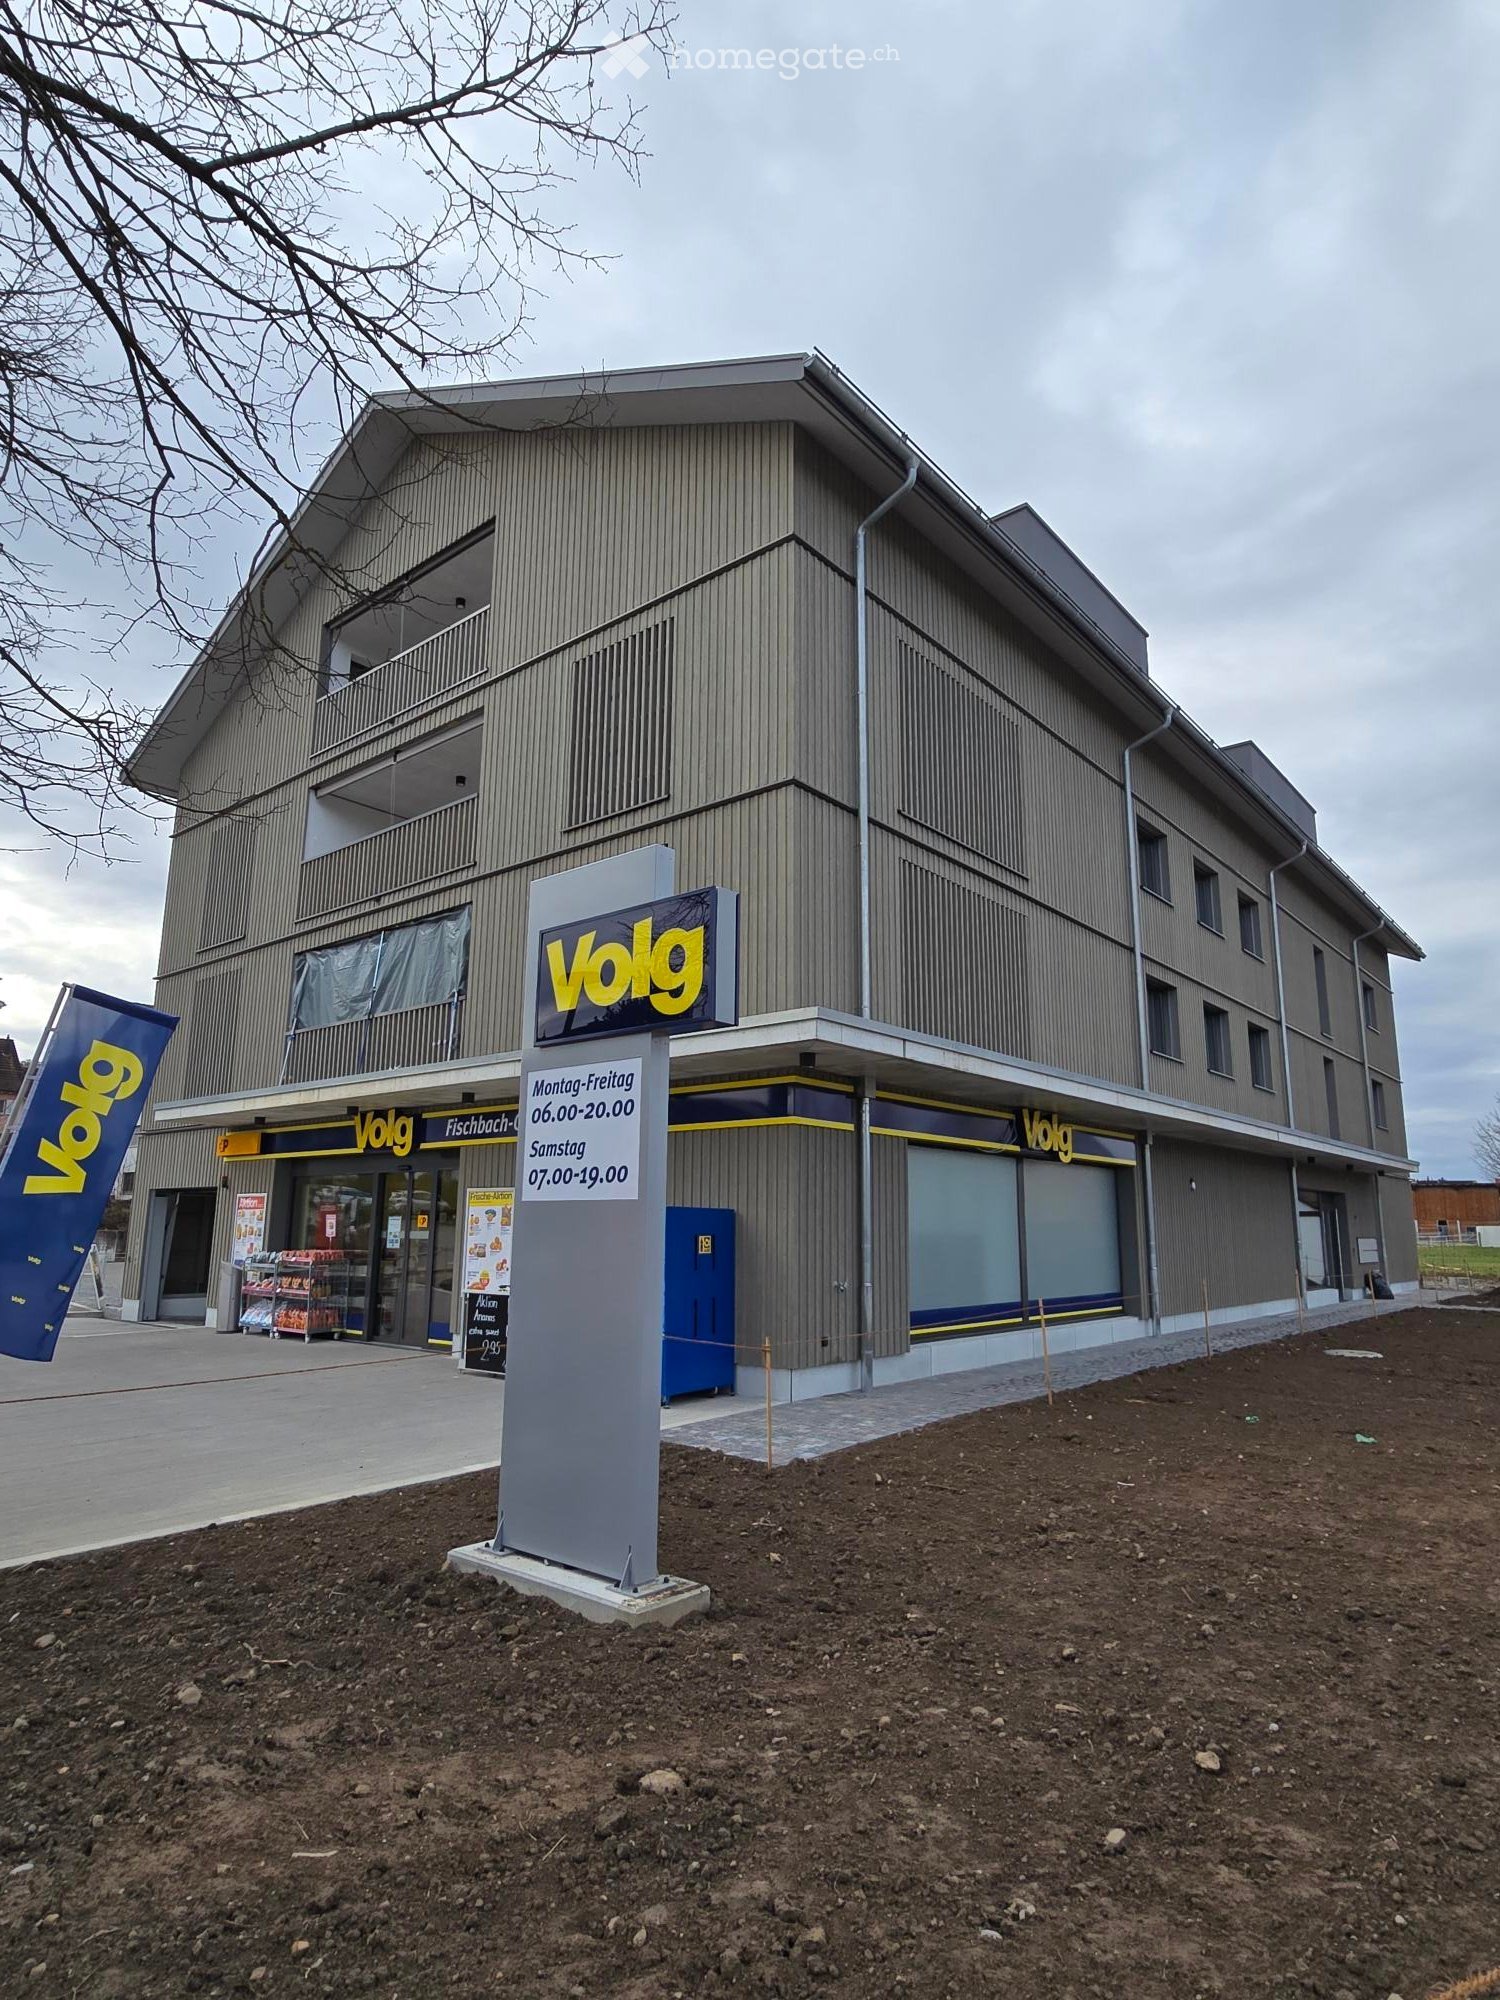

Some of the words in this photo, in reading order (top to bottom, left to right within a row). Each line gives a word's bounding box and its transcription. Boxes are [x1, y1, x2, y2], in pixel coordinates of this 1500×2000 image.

[546, 916, 705, 1016] Volg
[532, 1070, 635, 1098] Montag-Freitag
[22, 1039, 144, 1195] Volg
[531, 1098, 635, 1125] 06.00-20.00
[354, 1108, 413, 1157] Volg
[1022, 1108, 1073, 1164] Volg
[529, 1139, 586, 1160] Samstag
[528, 1165, 629, 1190] 07.00-19.00
[469, 1191, 513, 1201] Frische-Aktion
